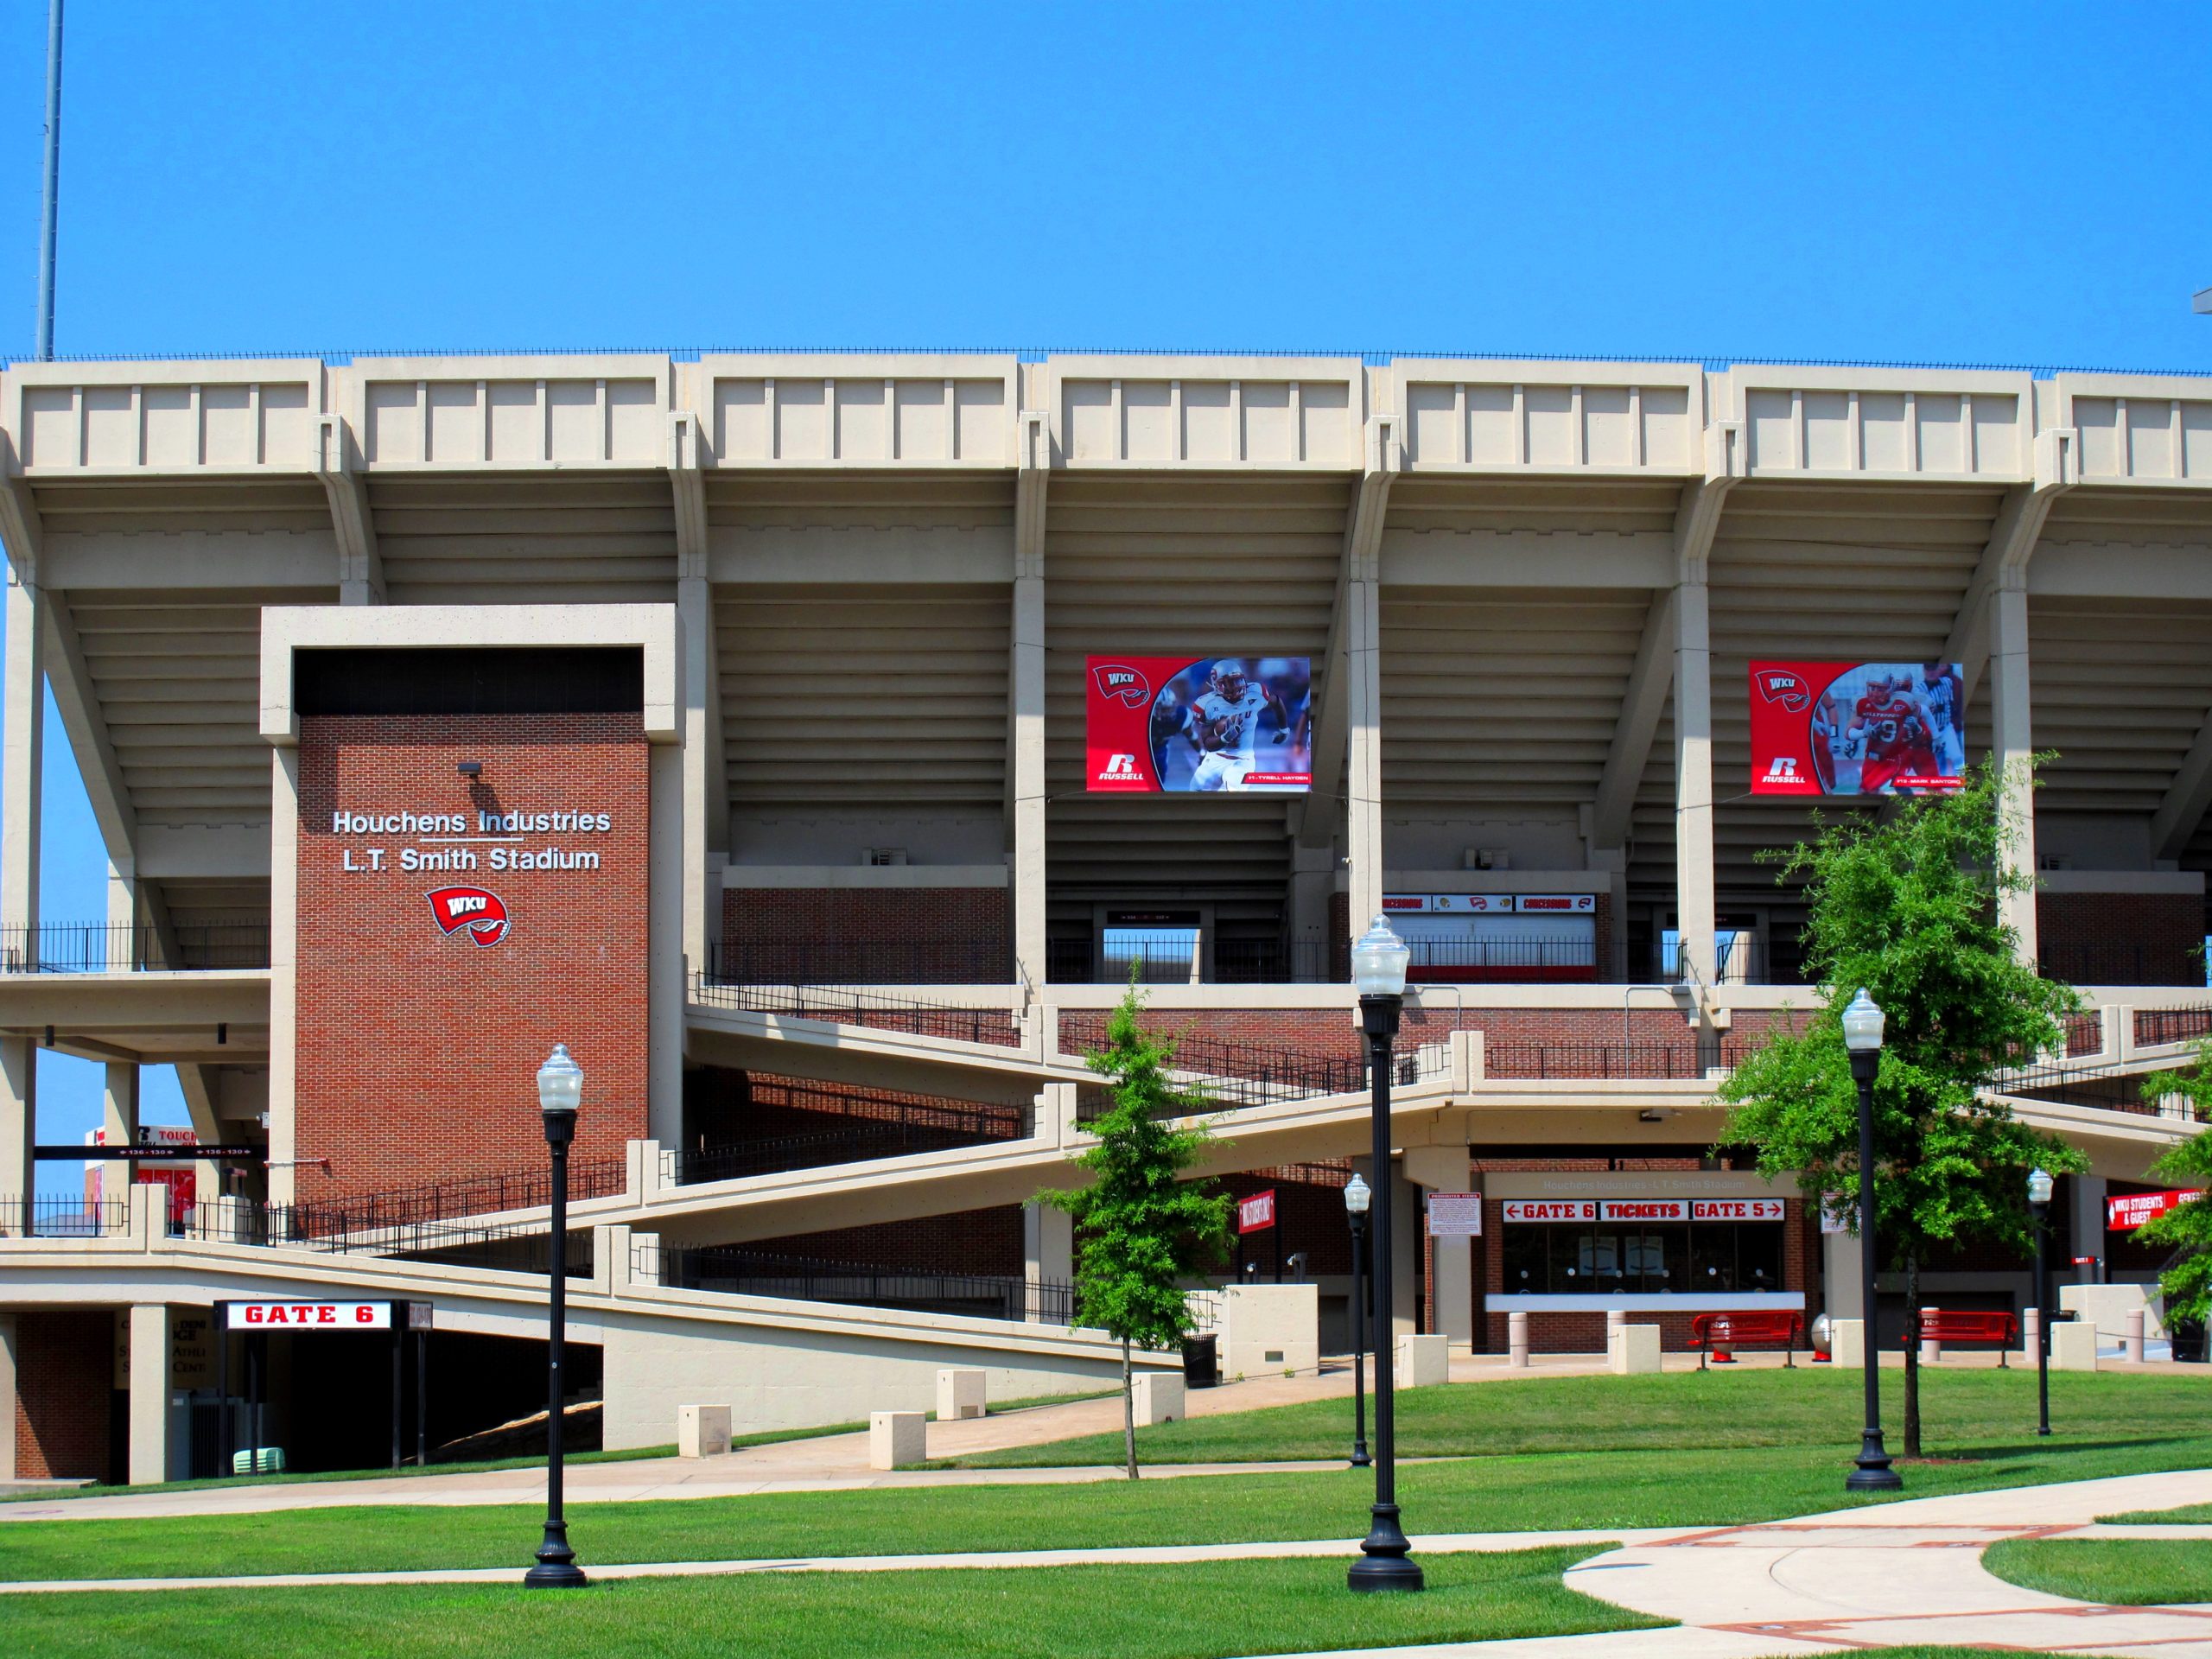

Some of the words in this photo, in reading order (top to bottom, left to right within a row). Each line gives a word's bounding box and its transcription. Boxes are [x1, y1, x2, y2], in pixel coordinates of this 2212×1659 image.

[1108, 673, 1135, 685] WKU
[1769, 677, 1796, 690] WKU
[1098, 772, 1144, 781] RUSSELL
[334, 810, 467, 833] Houchens
[479, 810, 612, 833] Industries
[343, 849, 387, 872] L.T.
[400, 848, 478, 871] Smith
[489, 848, 600, 871] Stadium
[446, 895, 487, 918] WKU
[1543, 1180, 1594, 1190] Houchens
[1596, 1179, 1646, 1190] Industries
[1673, 1179, 1701, 1190] Smith
[1702, 1179, 1745, 1190] Stadium
[1694, 1203, 1746, 1217] GATE
[1753, 1203, 1764, 1217] 5
[2114, 1198, 2130, 1211] WKU
[2130, 1195, 2164, 1211] STUDENTS
[1523, 1204, 1575, 1218] GATE
[1583, 1204, 1594, 1218] 6
[1605, 1204, 1681, 1218] TICKETS
[2130, 1211, 2152, 1225] GUEST
[245, 1306, 336, 1323] GATE
[355, 1306, 374, 1323] 6
